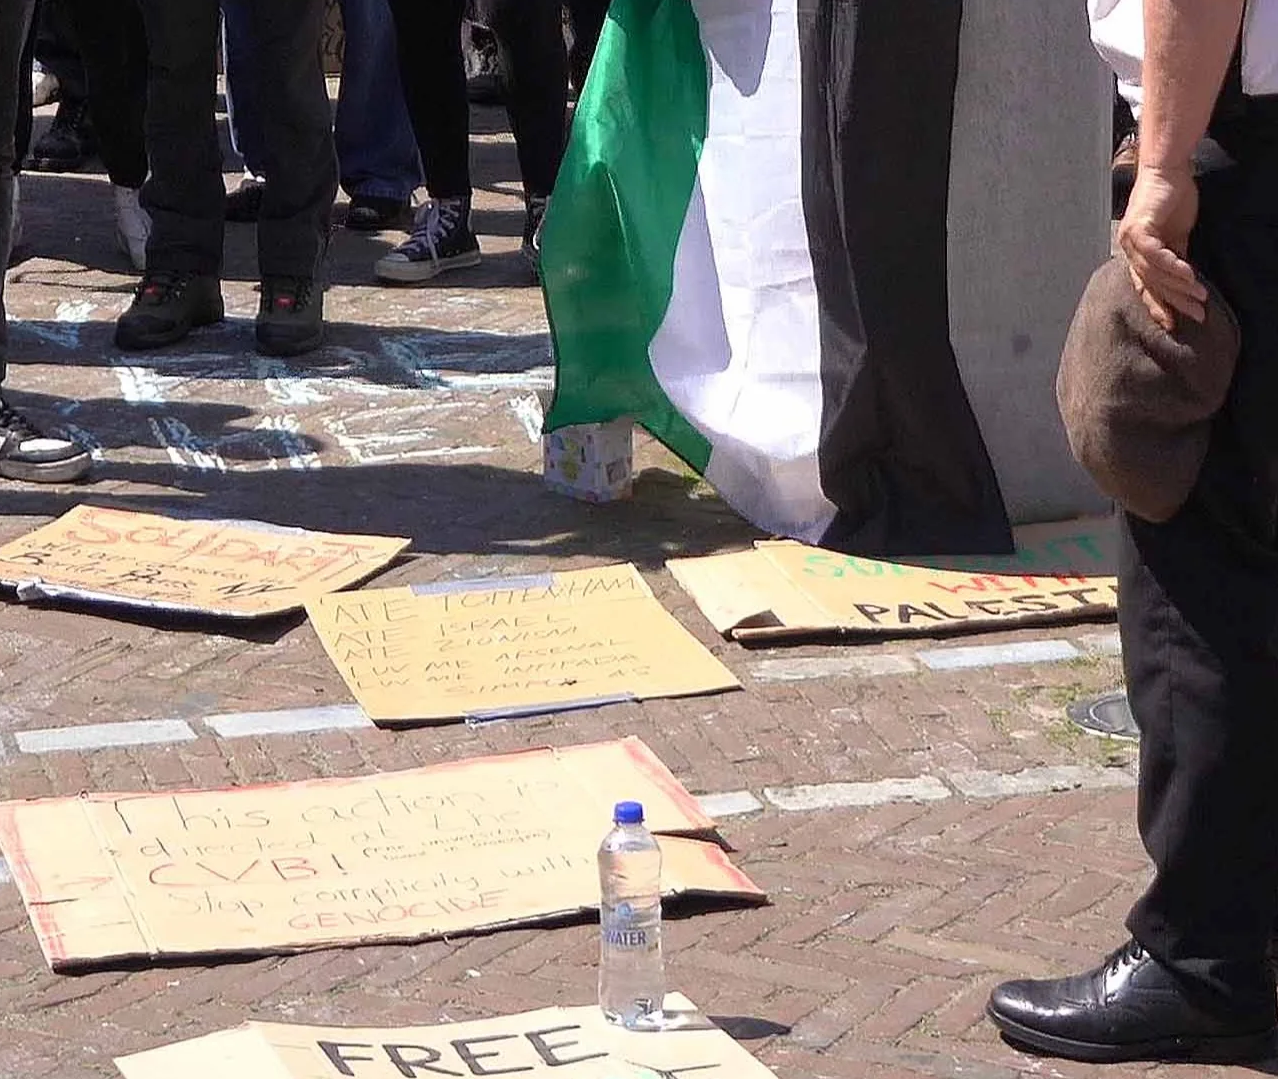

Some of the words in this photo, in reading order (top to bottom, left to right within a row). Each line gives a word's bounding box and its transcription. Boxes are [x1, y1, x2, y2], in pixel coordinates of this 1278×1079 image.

[854, 585, 1118, 624] PALEST
[439, 614, 570, 637] ISRAEL
[425, 660, 474, 673] ME
[114, 796, 272, 834] This
[300, 788, 487, 824] action
[286, 888, 509, 931] GENOCIDE
[316, 1023, 611, 1078] FREE
